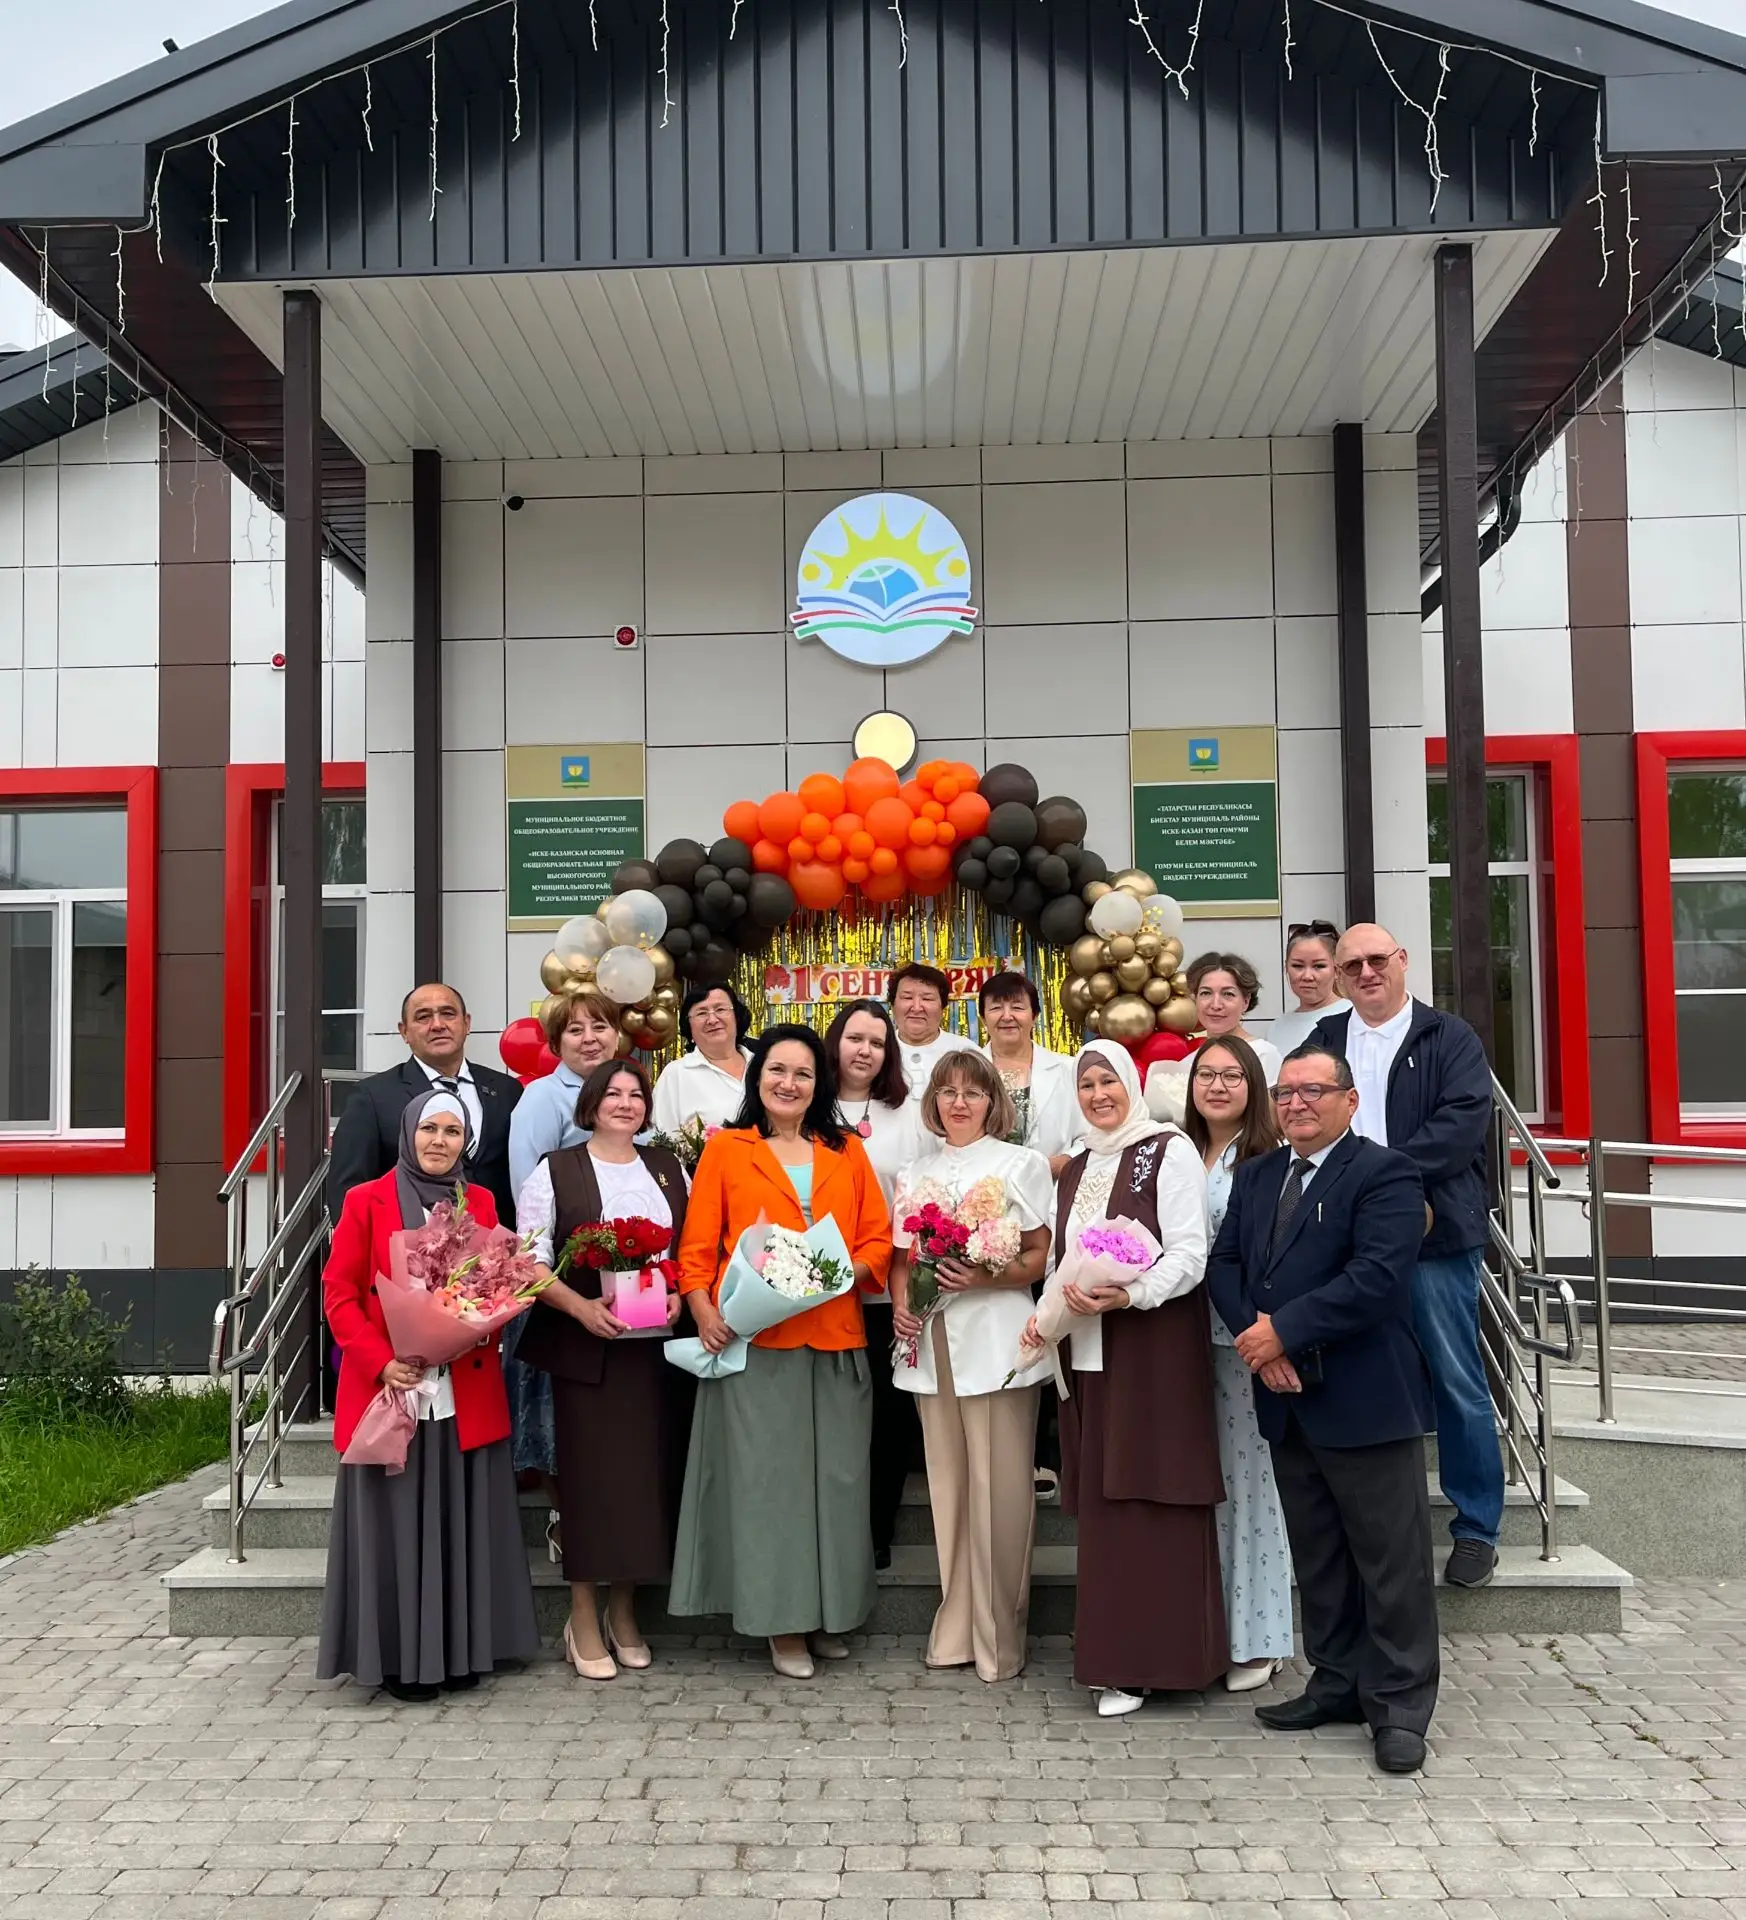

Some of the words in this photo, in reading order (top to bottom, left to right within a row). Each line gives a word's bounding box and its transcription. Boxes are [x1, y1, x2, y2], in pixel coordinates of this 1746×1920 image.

[1198, 803, 1253, 811] РЕСПУБЛИКАСЫ
[525, 816, 585, 824] МУНИЦИПАЛЬНОЕ
[585, 815, 627, 823] БЮДЖЕТНОЕ
[1150, 816, 1180, 824] БИЕКТАУ
[1181, 815, 1230, 823] МУНИЦИПАЛЬ
[1230, 813, 1260, 821] РАЙОНЫ
[513, 827, 594, 835] ОБЩЕОБРАЗОВАТЕЛЬНОЕ
[522, 861, 604, 869] ОБЩЕОБРАЗОВАТЕЛЬНАЯ
[531, 883, 595, 891] МУНИЦИПАЛЬНОГО
[791, 965, 813, 1002] 1
